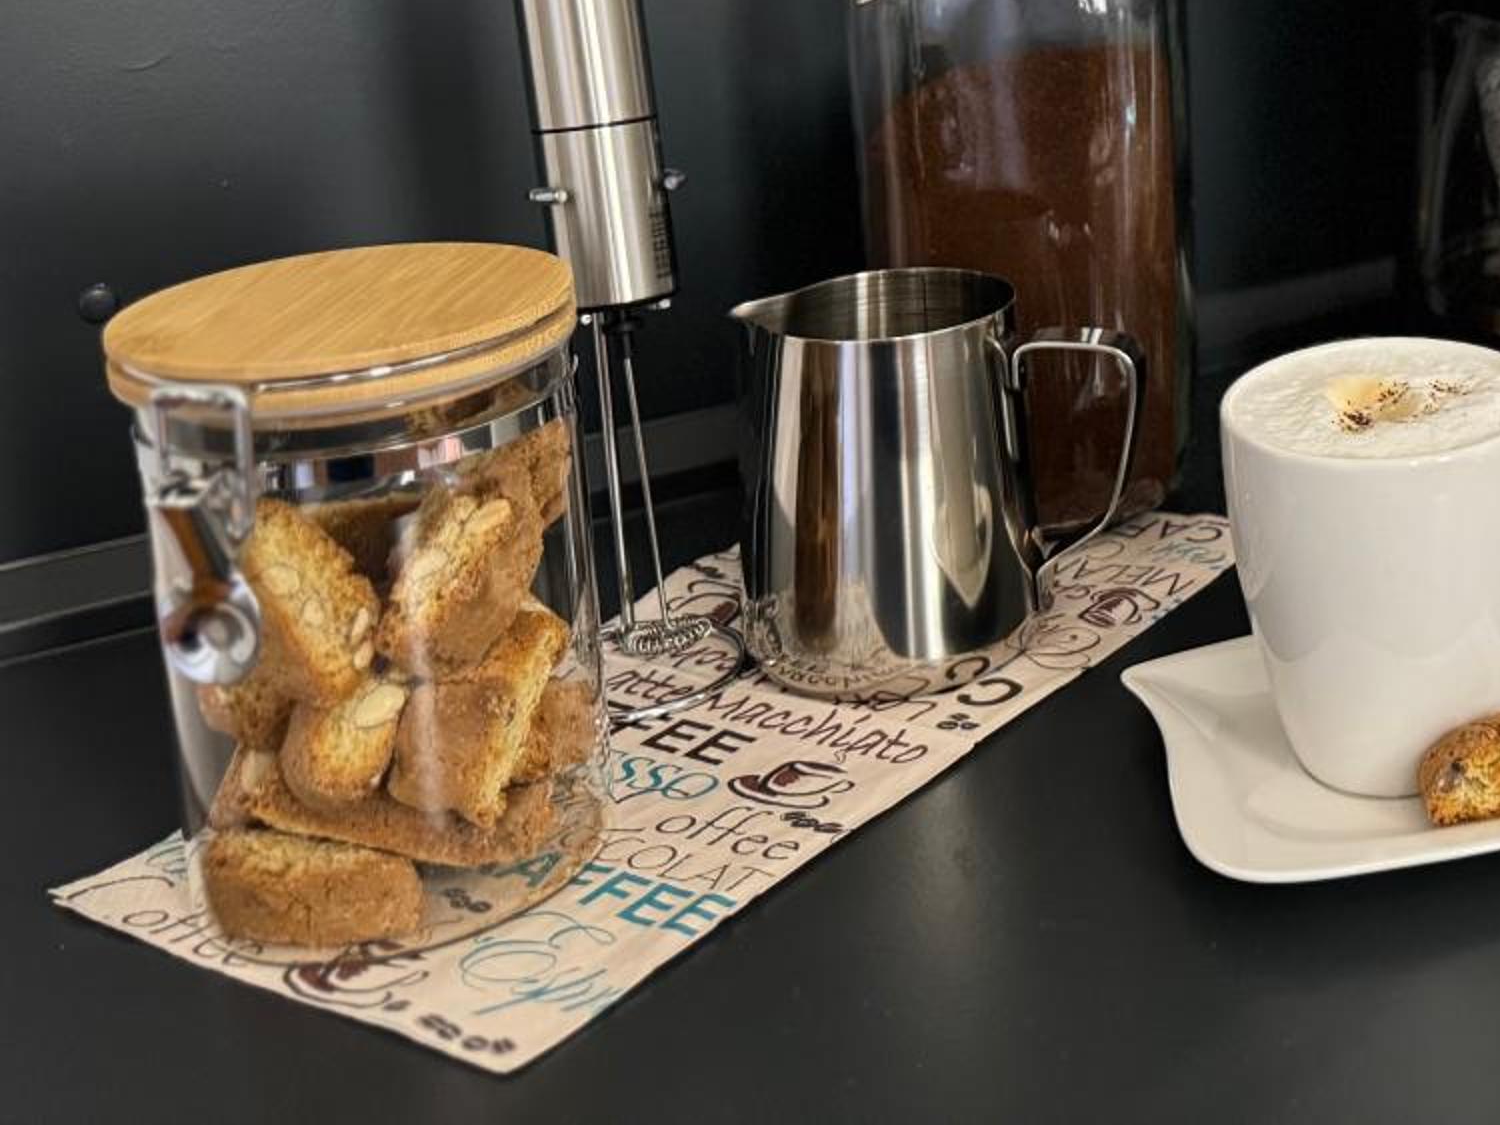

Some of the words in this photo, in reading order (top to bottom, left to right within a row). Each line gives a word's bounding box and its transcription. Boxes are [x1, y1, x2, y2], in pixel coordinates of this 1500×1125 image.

[607, 669, 694, 705] atte
[707, 691, 929, 764] Macchiato
[594, 837, 776, 891] COLAT
[652, 806, 799, 861] offee
[505, 851, 737, 938] AFFEE
